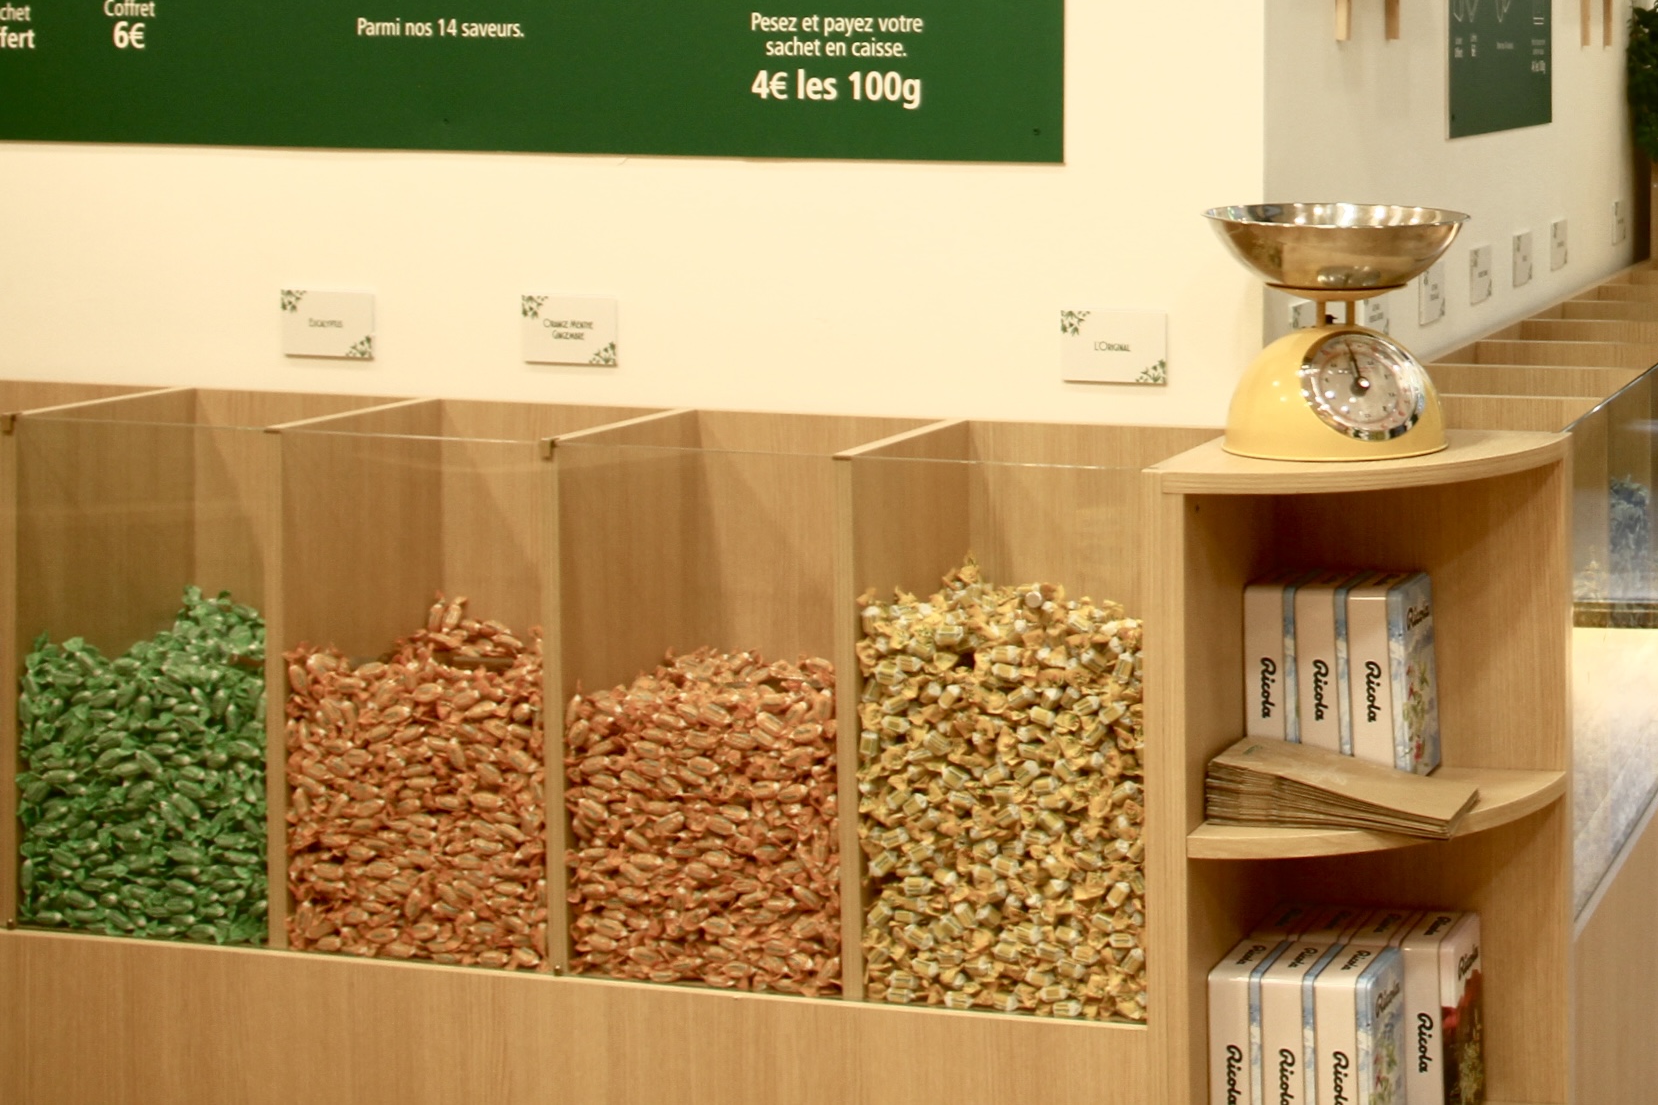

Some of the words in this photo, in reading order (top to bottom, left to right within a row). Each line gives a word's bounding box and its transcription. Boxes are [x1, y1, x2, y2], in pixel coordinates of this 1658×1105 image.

[113, 20, 146, 49] 6€
[357, 17, 401, 36] Parmi
[405, 21, 433, 37] nos
[437, 18, 458, 37] 14
[461, 22, 525, 38] saveurs.
[751, 12, 798, 32] Pesez
[802, 14, 820, 32] et
[824, 17, 874, 37] payez
[877, 15, 924, 33] votre
[765, 37, 821, 57] sachet
[825, 41, 847, 57] en
[851, 39, 908, 57] caisse.
[751, 70, 788, 100] 4€
[797, 69, 838, 101] les
[848, 71, 921, 110] 100g
[1260, 656, 1277, 719] Ricola
[1312, 659, 1330, 722] Ricola
[1365, 660, 1382, 723] Ricola
[1416, 1012, 1434, 1073] Ricola
[1226, 1044, 1243, 1105] Ricola
